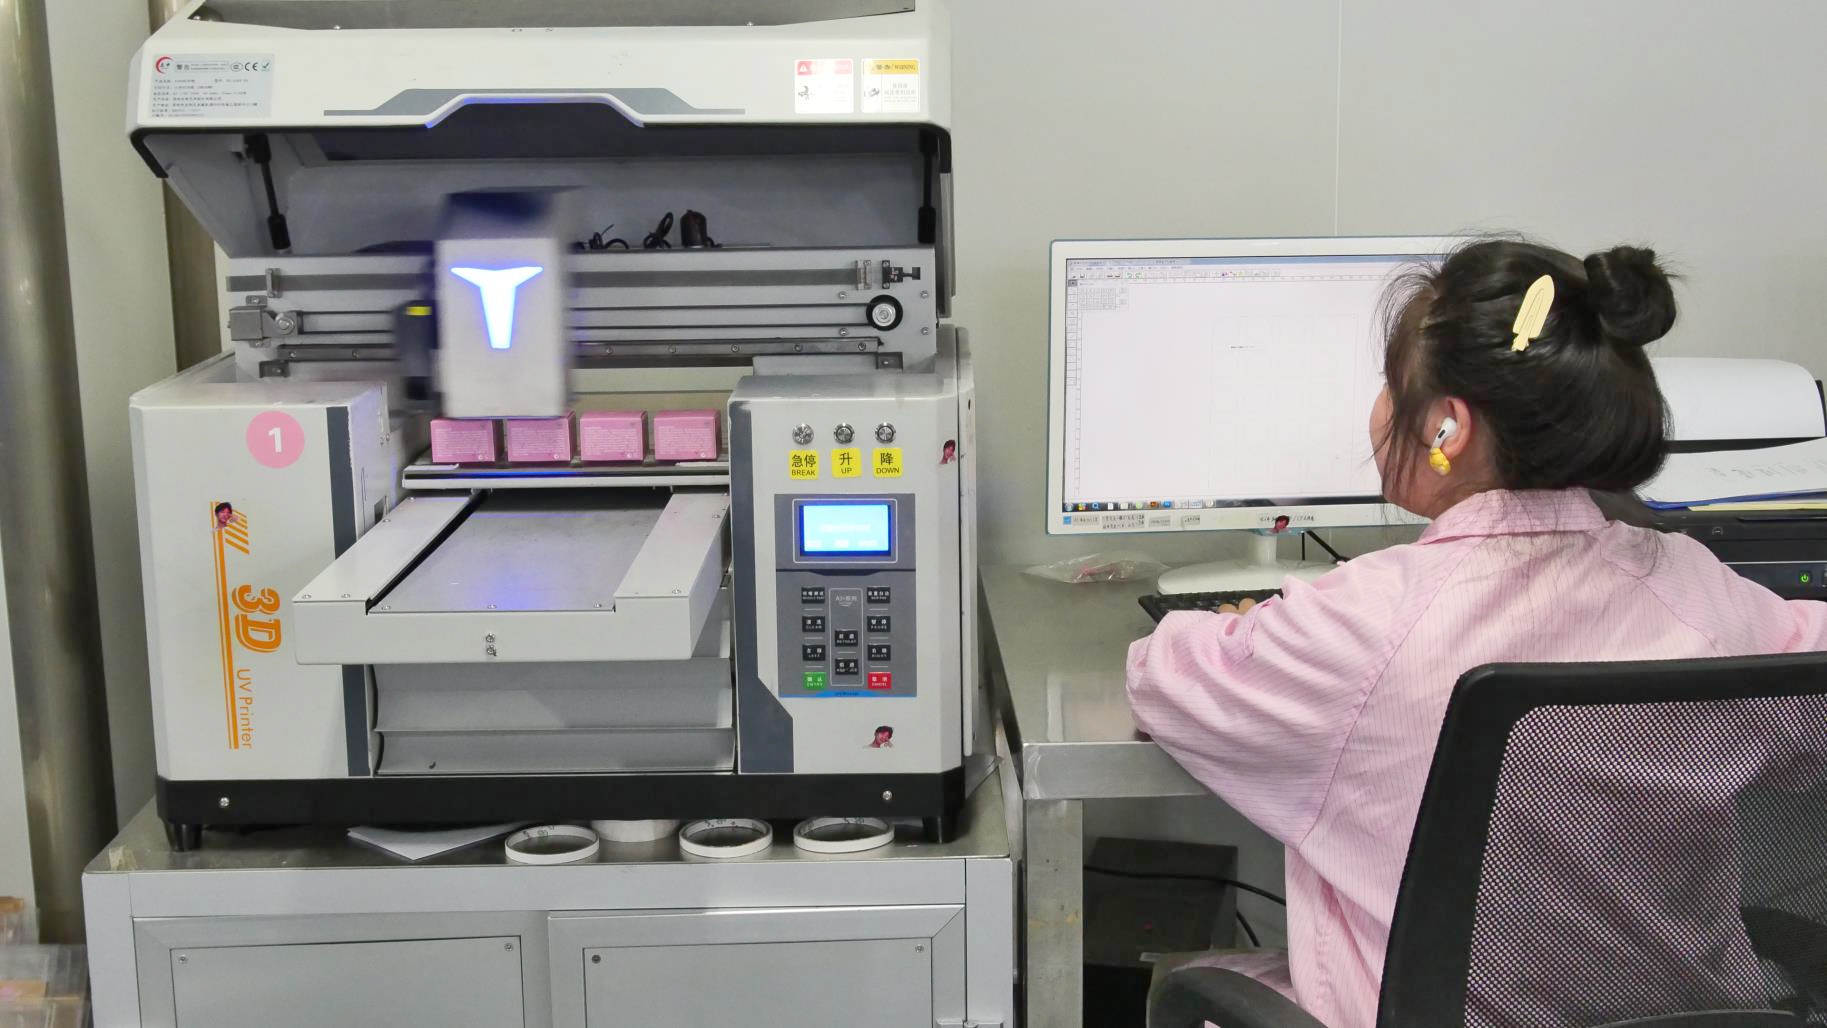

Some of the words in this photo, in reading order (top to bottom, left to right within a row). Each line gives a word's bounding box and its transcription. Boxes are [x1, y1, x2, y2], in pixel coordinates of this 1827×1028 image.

[267, 426, 283, 453] 1
[791, 454, 817, 468] 急停
[839, 452, 853, 466] 升
[880, 452, 894, 466] 降
[791, 469, 816, 477] BREAK
[841, 467, 852, 475] UP
[876, 467, 900, 475] DOWN
[231, 584, 282, 653] 3D
[236, 669, 252, 692] UV
[238, 695, 254, 750] Printer
